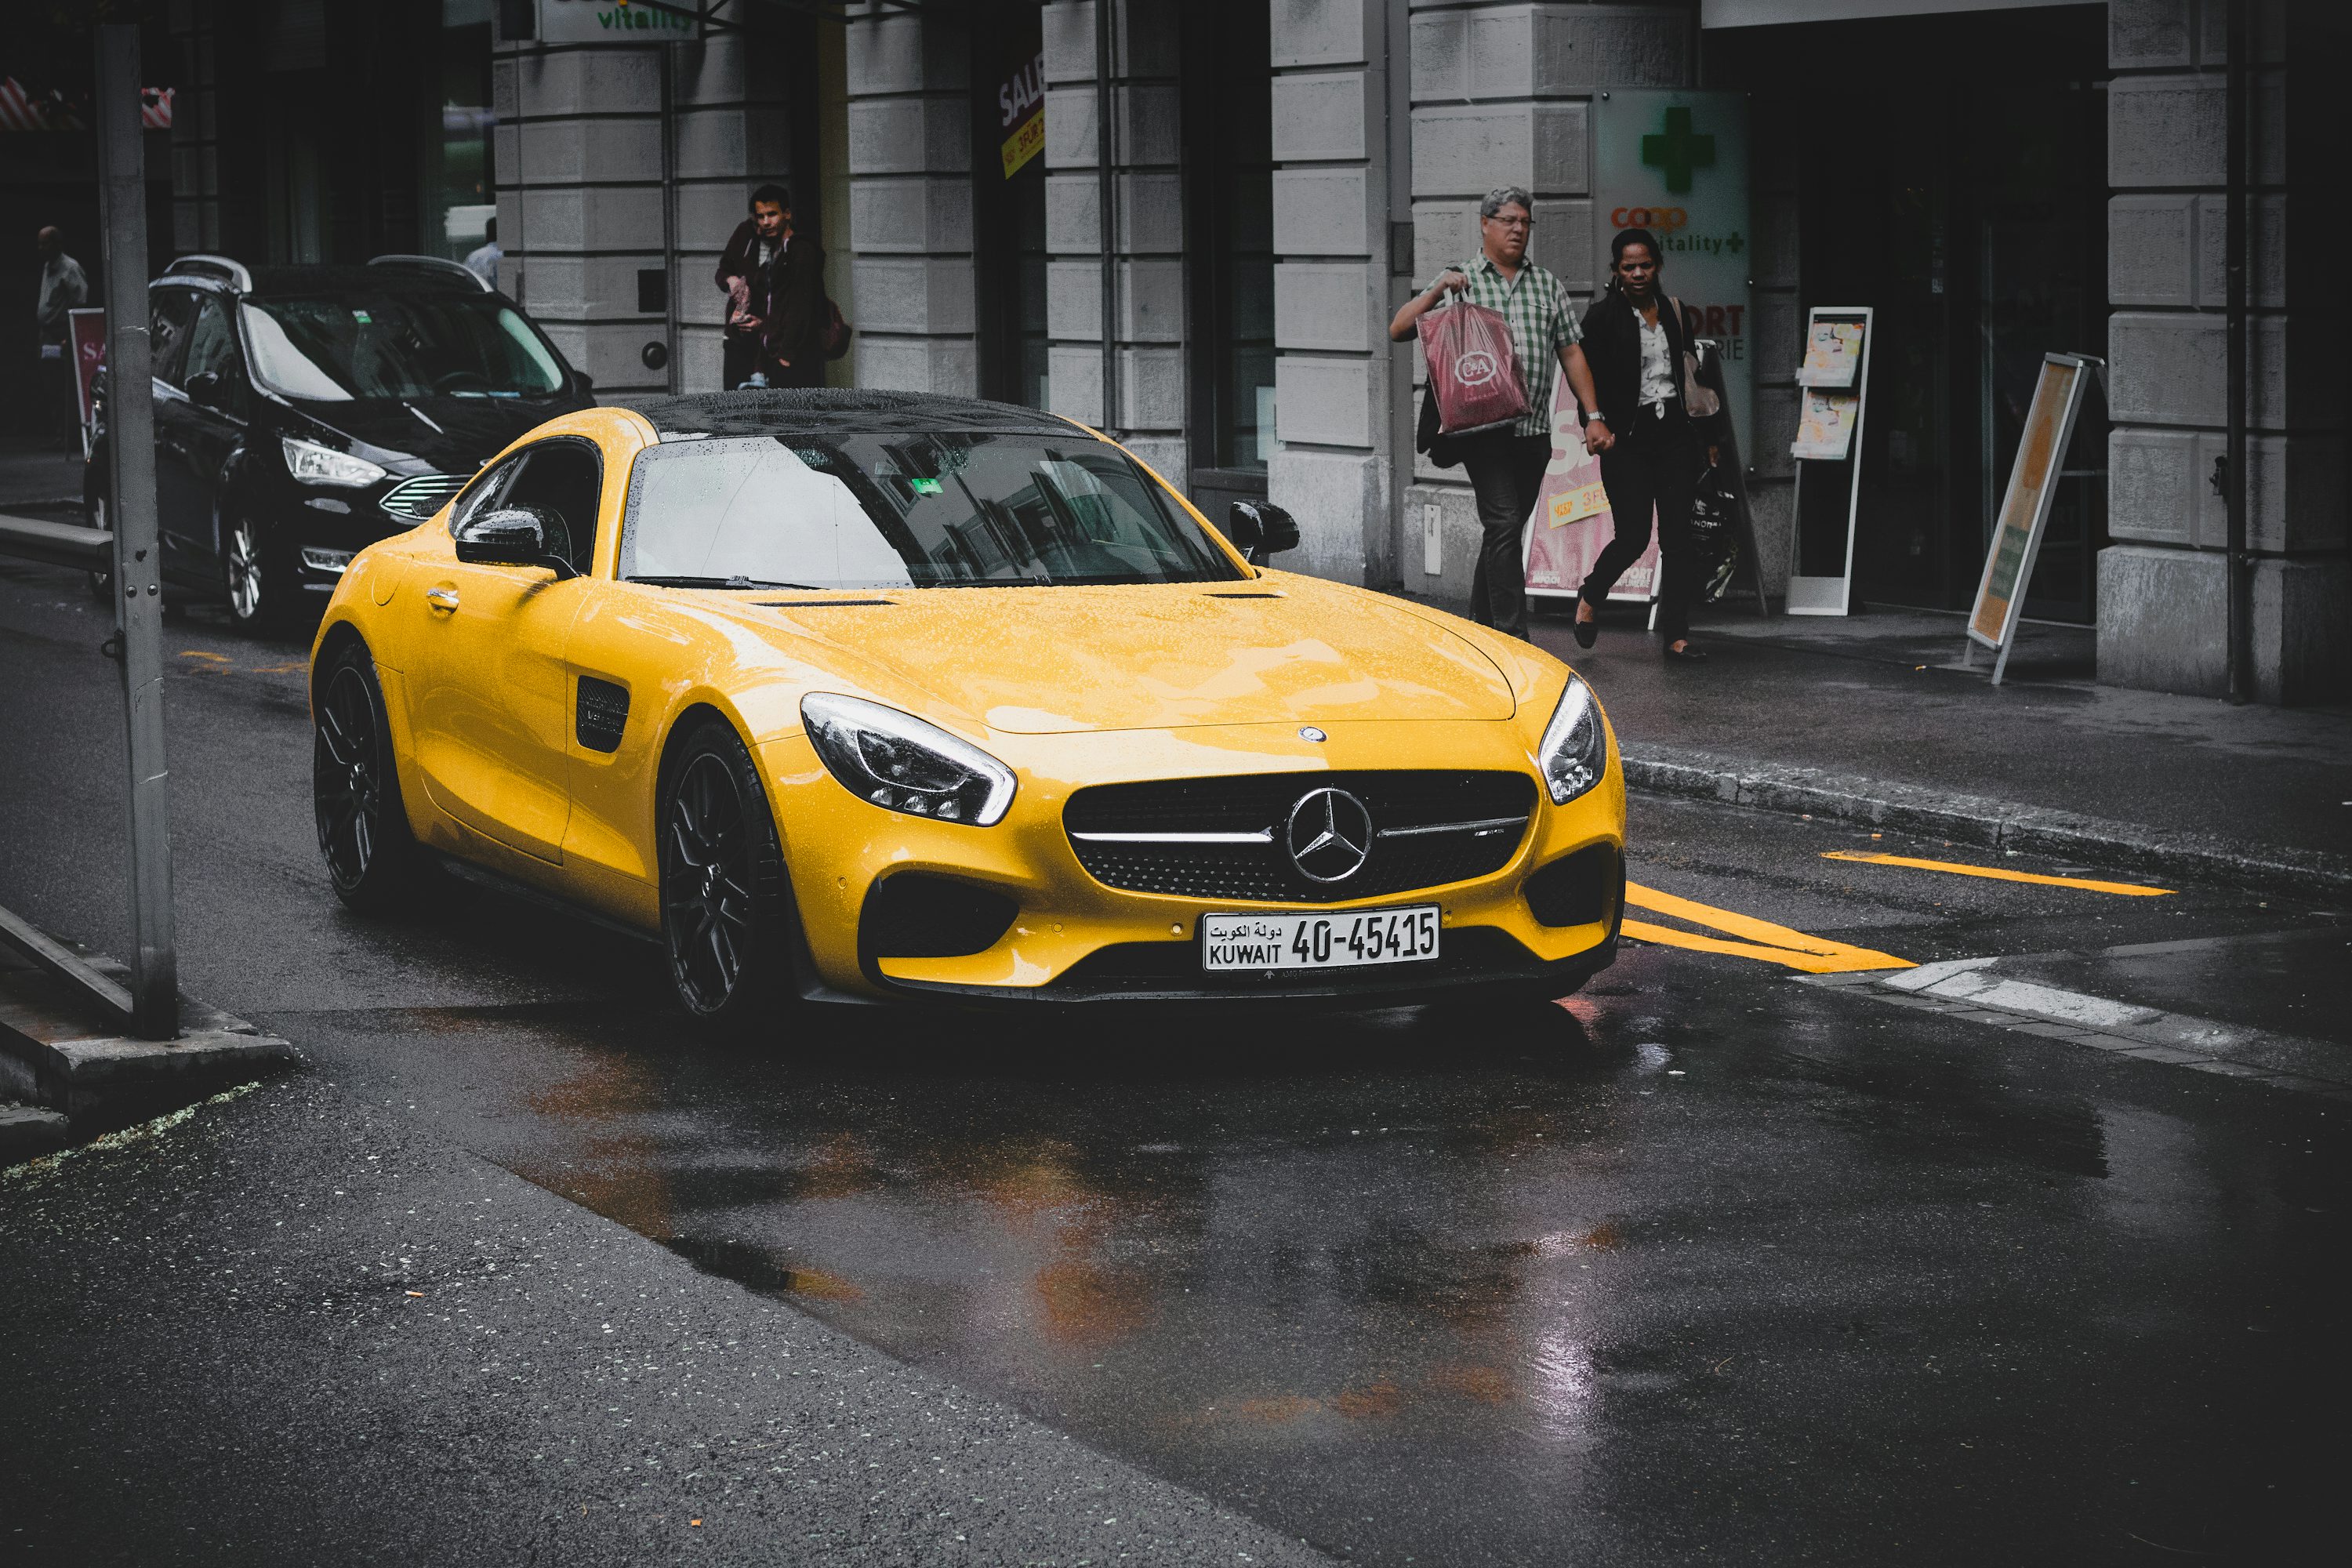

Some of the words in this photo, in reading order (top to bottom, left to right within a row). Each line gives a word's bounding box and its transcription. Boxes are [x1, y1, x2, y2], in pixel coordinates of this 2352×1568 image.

[1610, 207, 1688, 234] coop
[1658, 235, 1722, 256] itality
[1686, 305, 1744, 336] ORT
[1462, 358, 1490, 377] C&A
[1210, 925, 1250, 942] الكويت
[1254, 922, 1282, 939] دولة
[1293, 913, 1434, 963] 40-45415
[1210, 944, 1282, 964] KUWAIT
